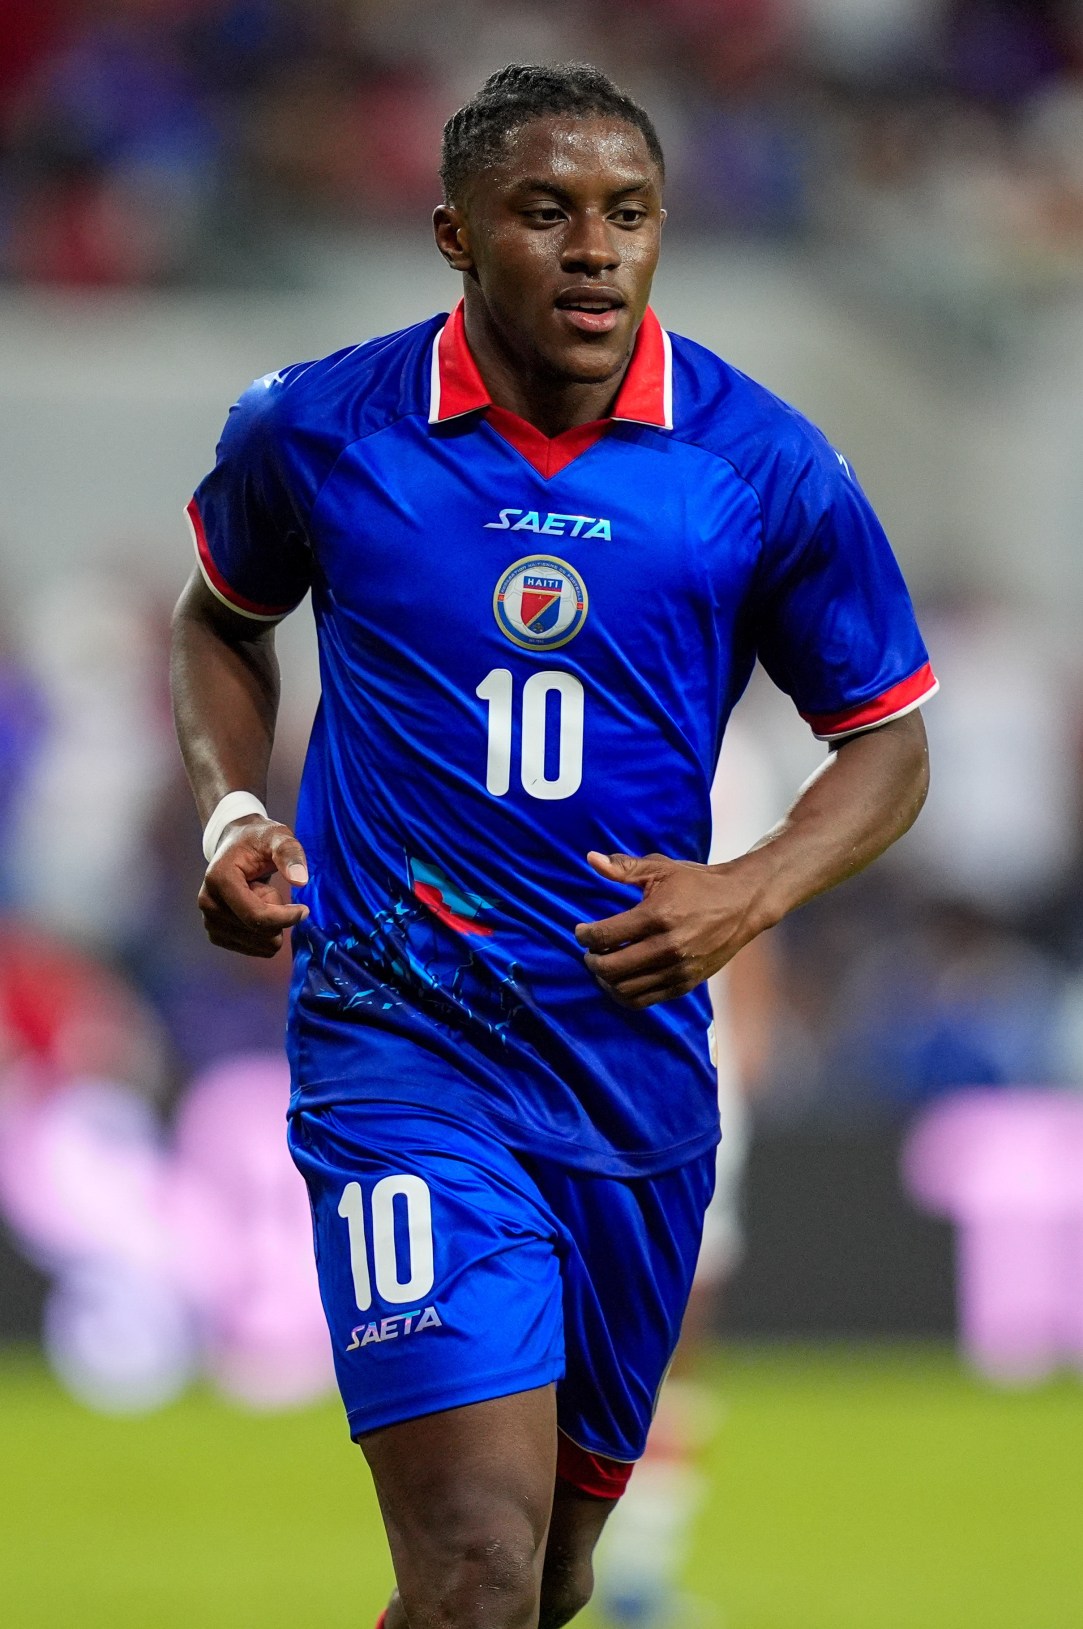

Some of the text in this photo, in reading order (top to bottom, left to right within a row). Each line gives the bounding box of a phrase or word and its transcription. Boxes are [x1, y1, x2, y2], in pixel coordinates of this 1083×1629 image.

[483, 508, 611, 541] SAETA
[527, 577, 559, 588] HAITI
[476, 668, 585, 800] 10
[338, 1174, 434, 1311] 10
[345, 1306, 442, 1351] SAETA
